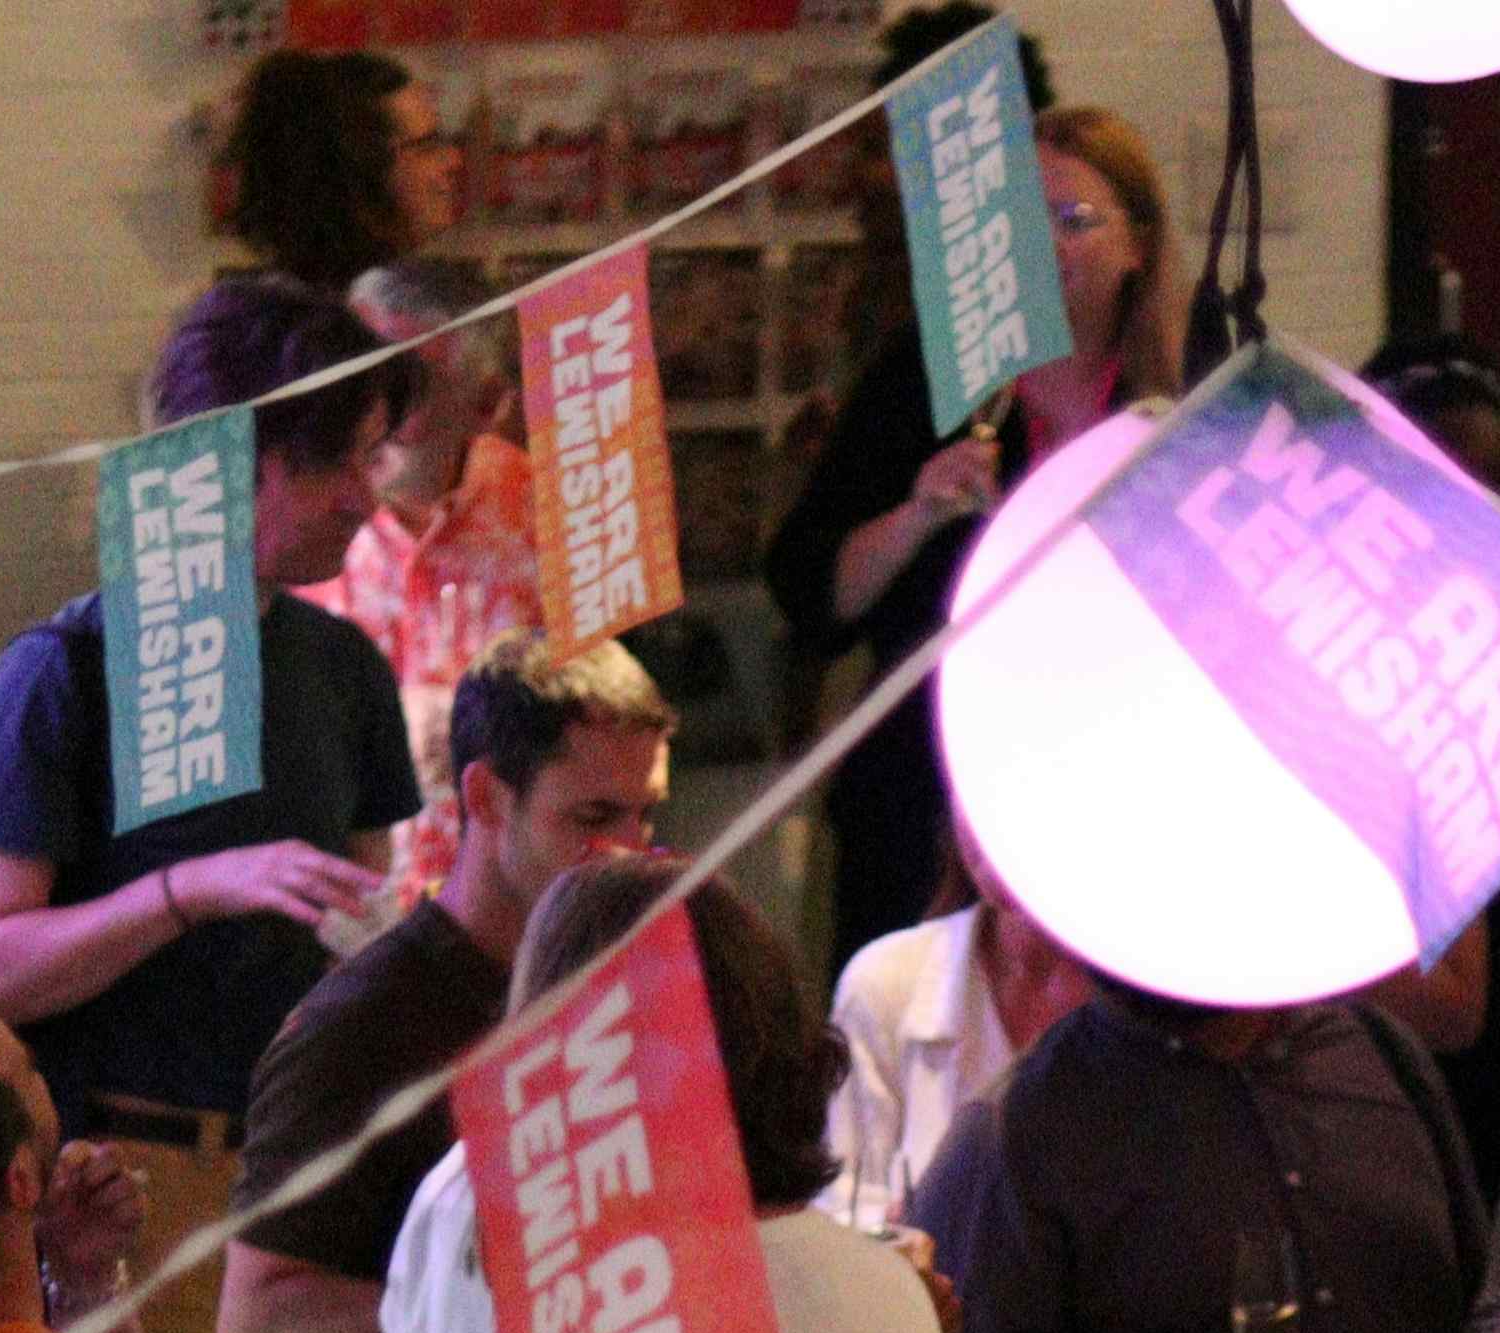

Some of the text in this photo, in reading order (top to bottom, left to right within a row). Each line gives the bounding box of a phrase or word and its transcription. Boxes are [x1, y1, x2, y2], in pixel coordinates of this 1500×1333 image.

[928, 96, 990, 401] LEWISHAM
[968, 64, 1029, 374] WE ARE
[550, 314, 605, 641] LEWISHAM
[589, 292, 650, 622] WE ARE
[1238, 400, 1436, 594] WE
[130, 467, 180, 808] LEWISHAM
[169, 452, 227, 795] WE ARE
[562, 982, 655, 1226] WE
